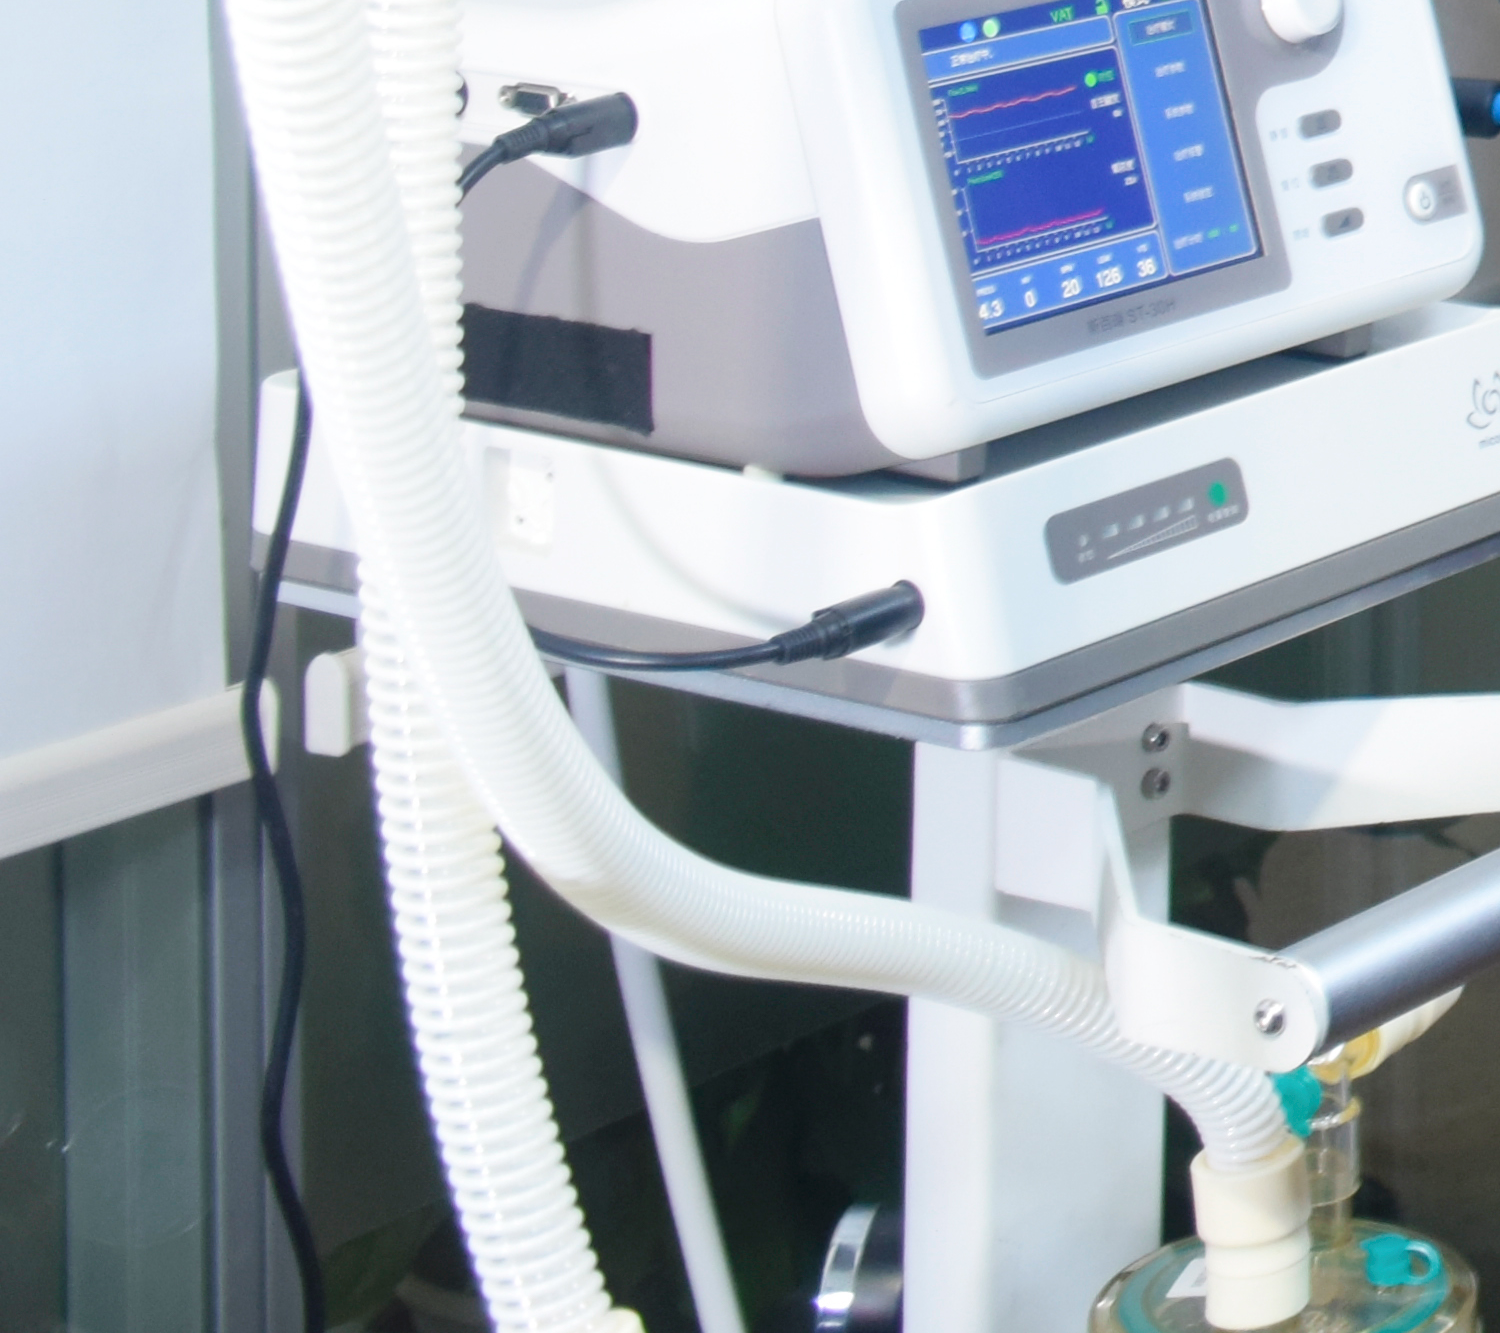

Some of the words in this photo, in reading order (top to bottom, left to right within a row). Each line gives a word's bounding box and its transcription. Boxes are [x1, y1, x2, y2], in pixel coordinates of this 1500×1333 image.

[1024, 289, 1037, 308] 0
[1061, 277, 1081, 299] 20
[1095, 266, 1123, 288] 126
[1136, 257, 1157, 278] 36
